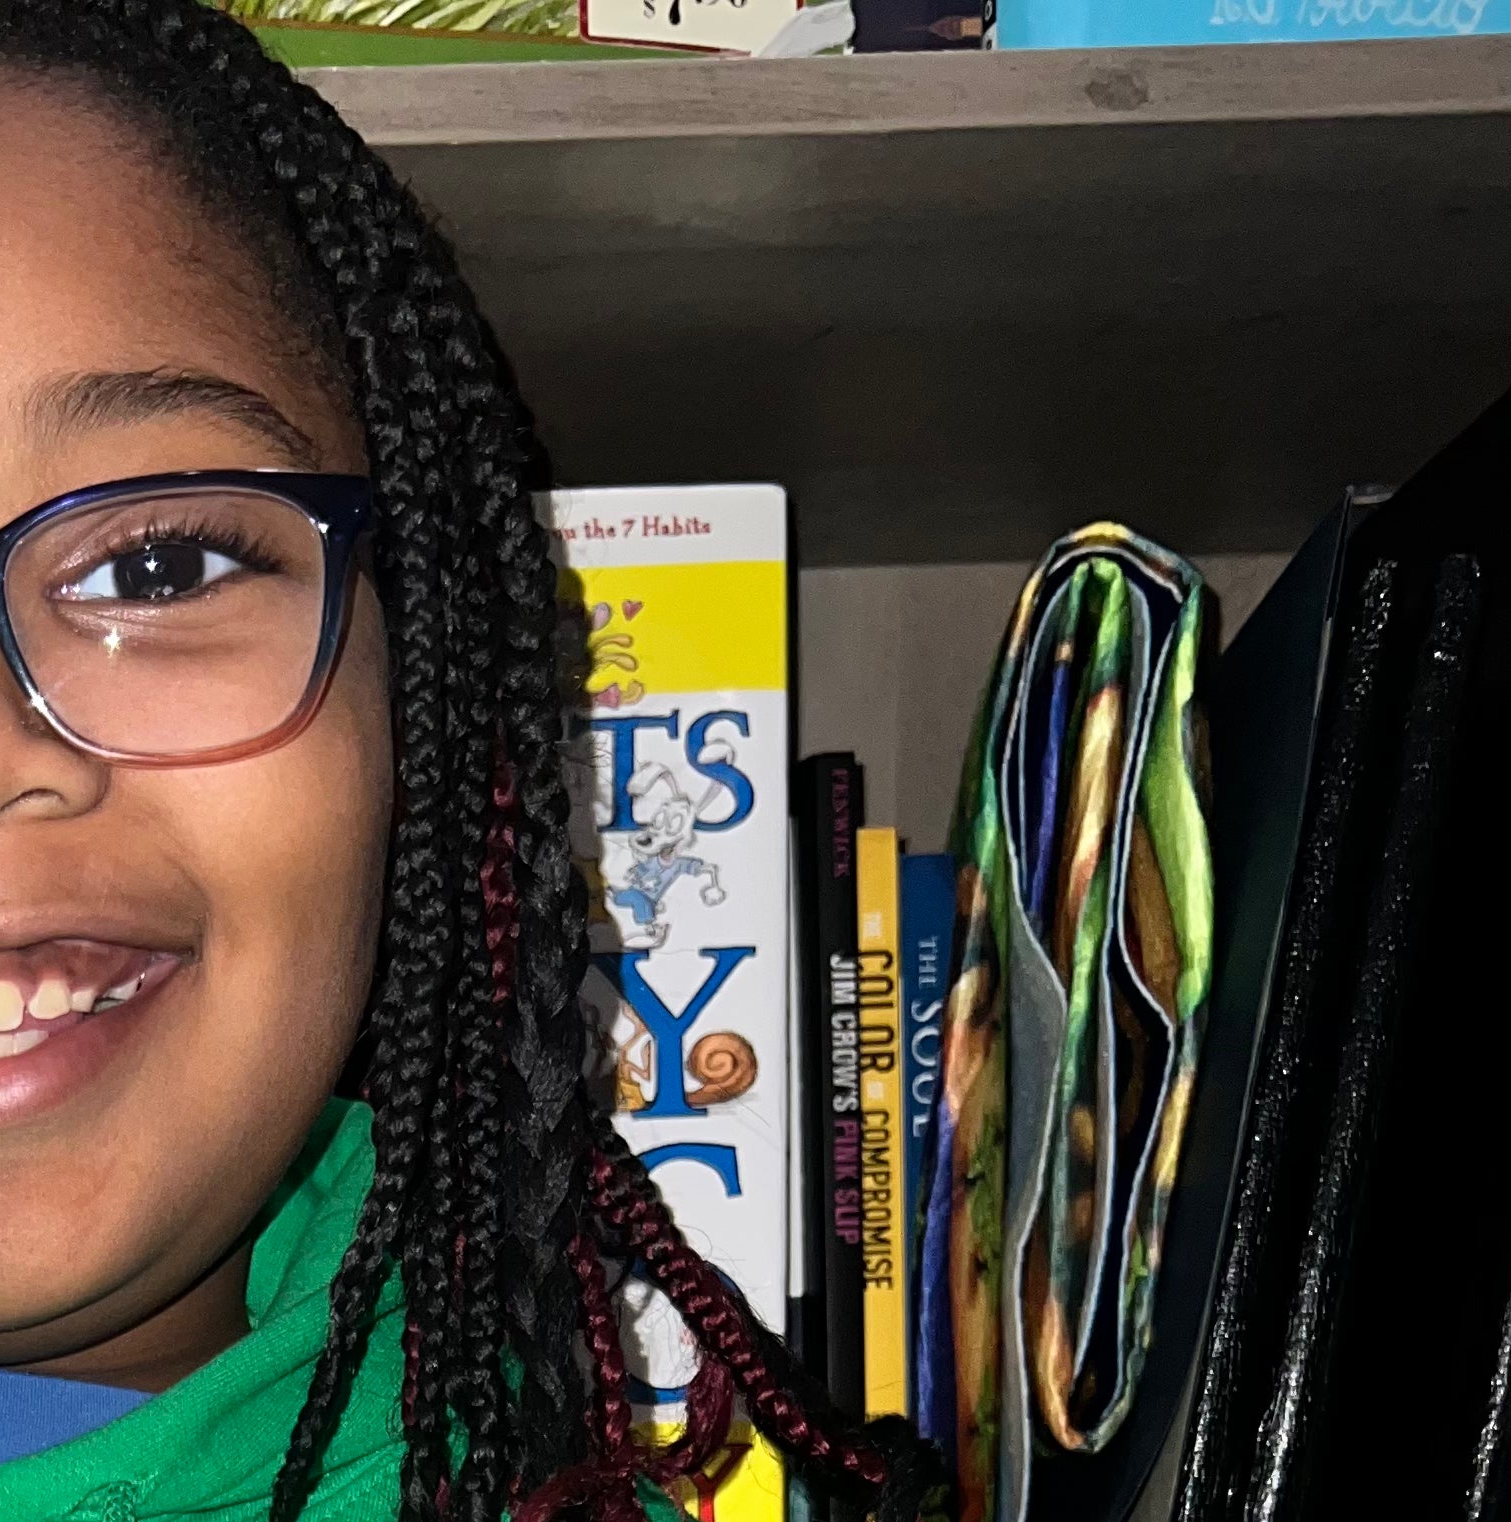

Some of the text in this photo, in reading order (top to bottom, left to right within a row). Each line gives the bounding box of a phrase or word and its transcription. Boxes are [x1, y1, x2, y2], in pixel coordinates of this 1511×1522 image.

[584, 518, 616, 540] the
[622, 518, 636, 539] 7
[642, 514, 712, 538] Habits
[831, 768, 850, 880] FENWICK
[857, 949, 895, 1073] COLOR
[917, 935, 940, 990] THE
[830, 953, 860, 1245] JIM CROW'S PINK SLIP
[861, 1109, 895, 1291] COMPROMISE
